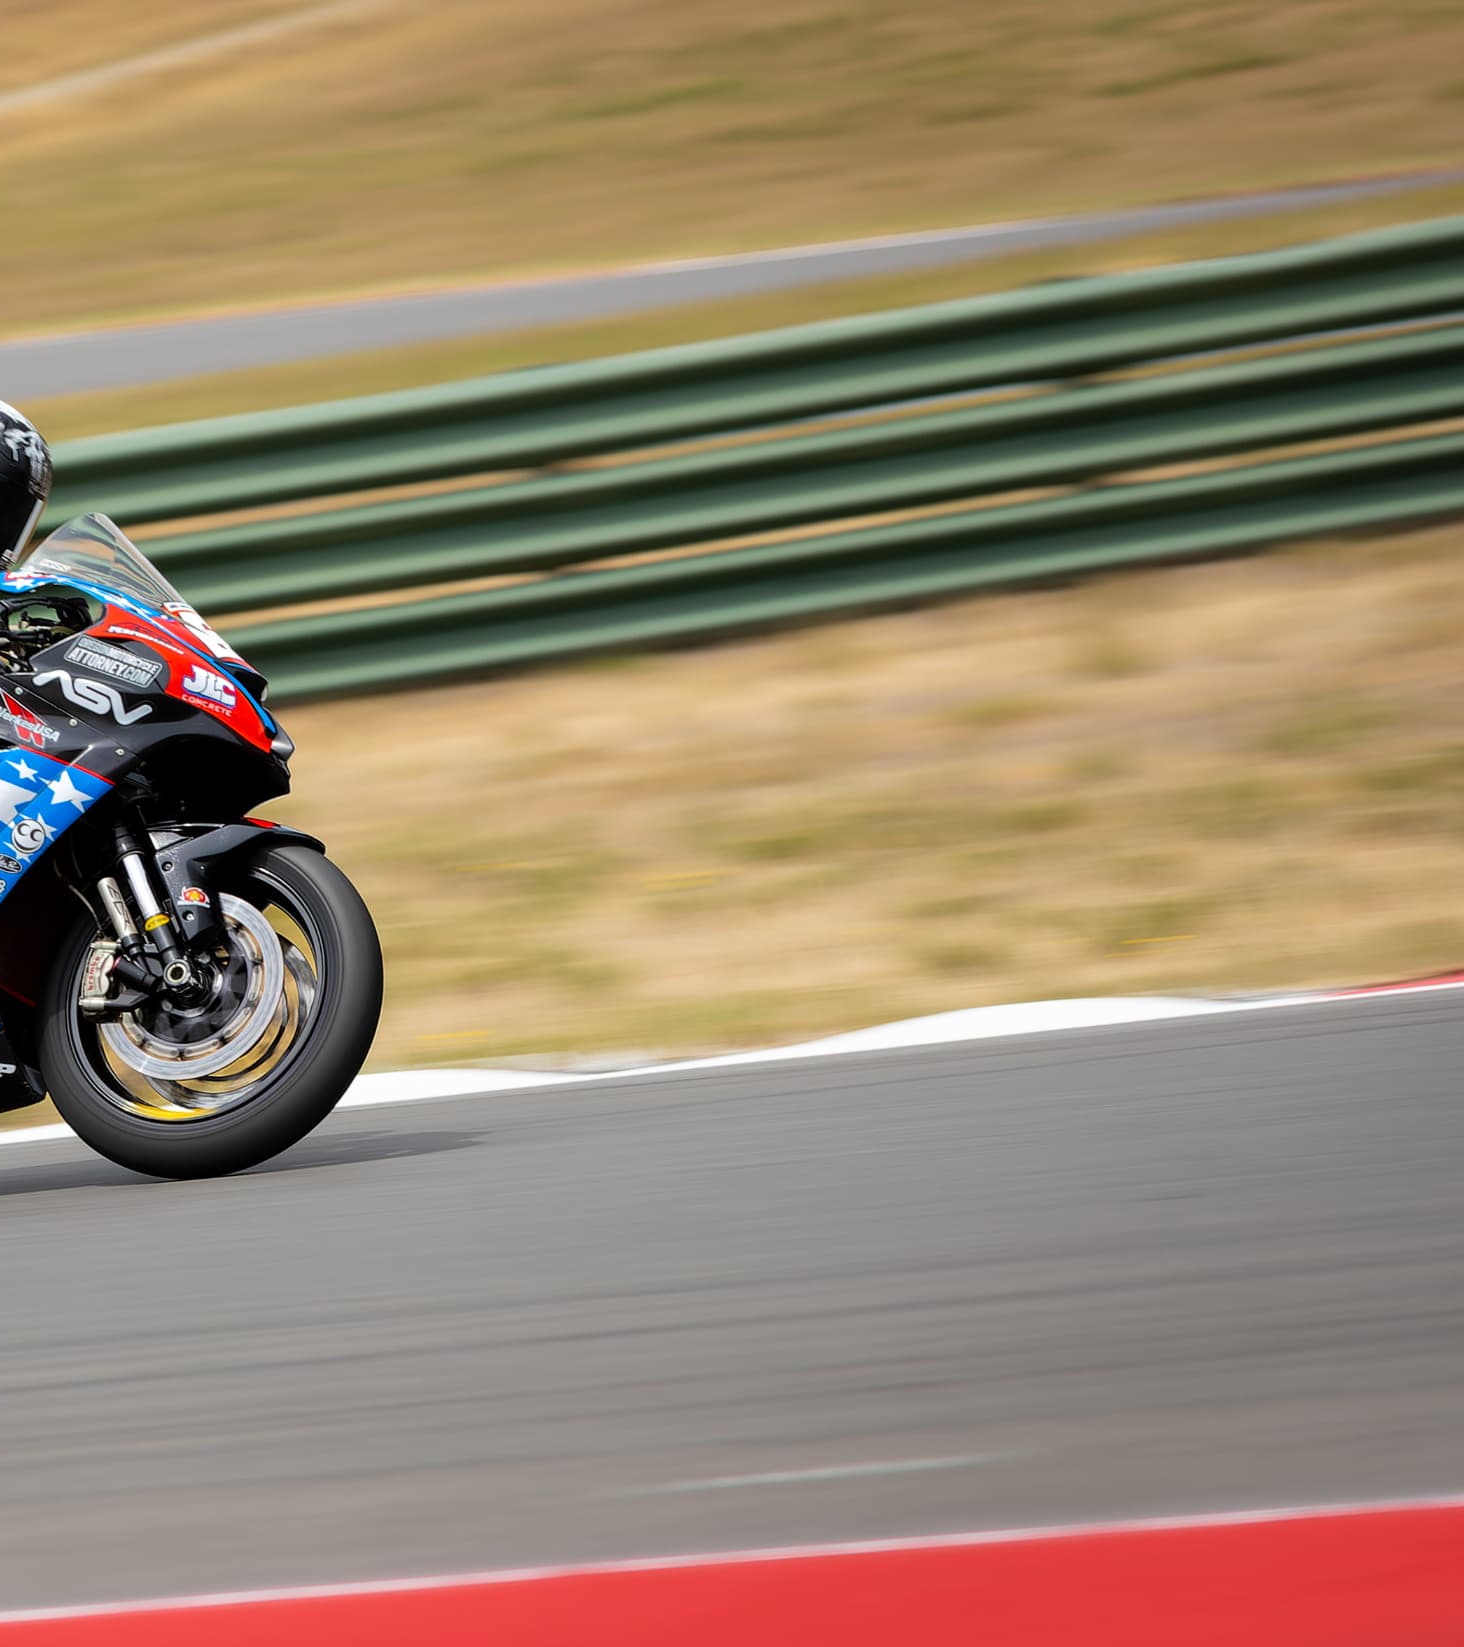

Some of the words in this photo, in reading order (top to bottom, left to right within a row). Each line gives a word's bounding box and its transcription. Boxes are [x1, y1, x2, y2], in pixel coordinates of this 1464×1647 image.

[67, 647, 152, 685] ATTORNEY.COM
[32, 669, 153, 726] ASV
[182, 694, 233, 717] CONCRETE
